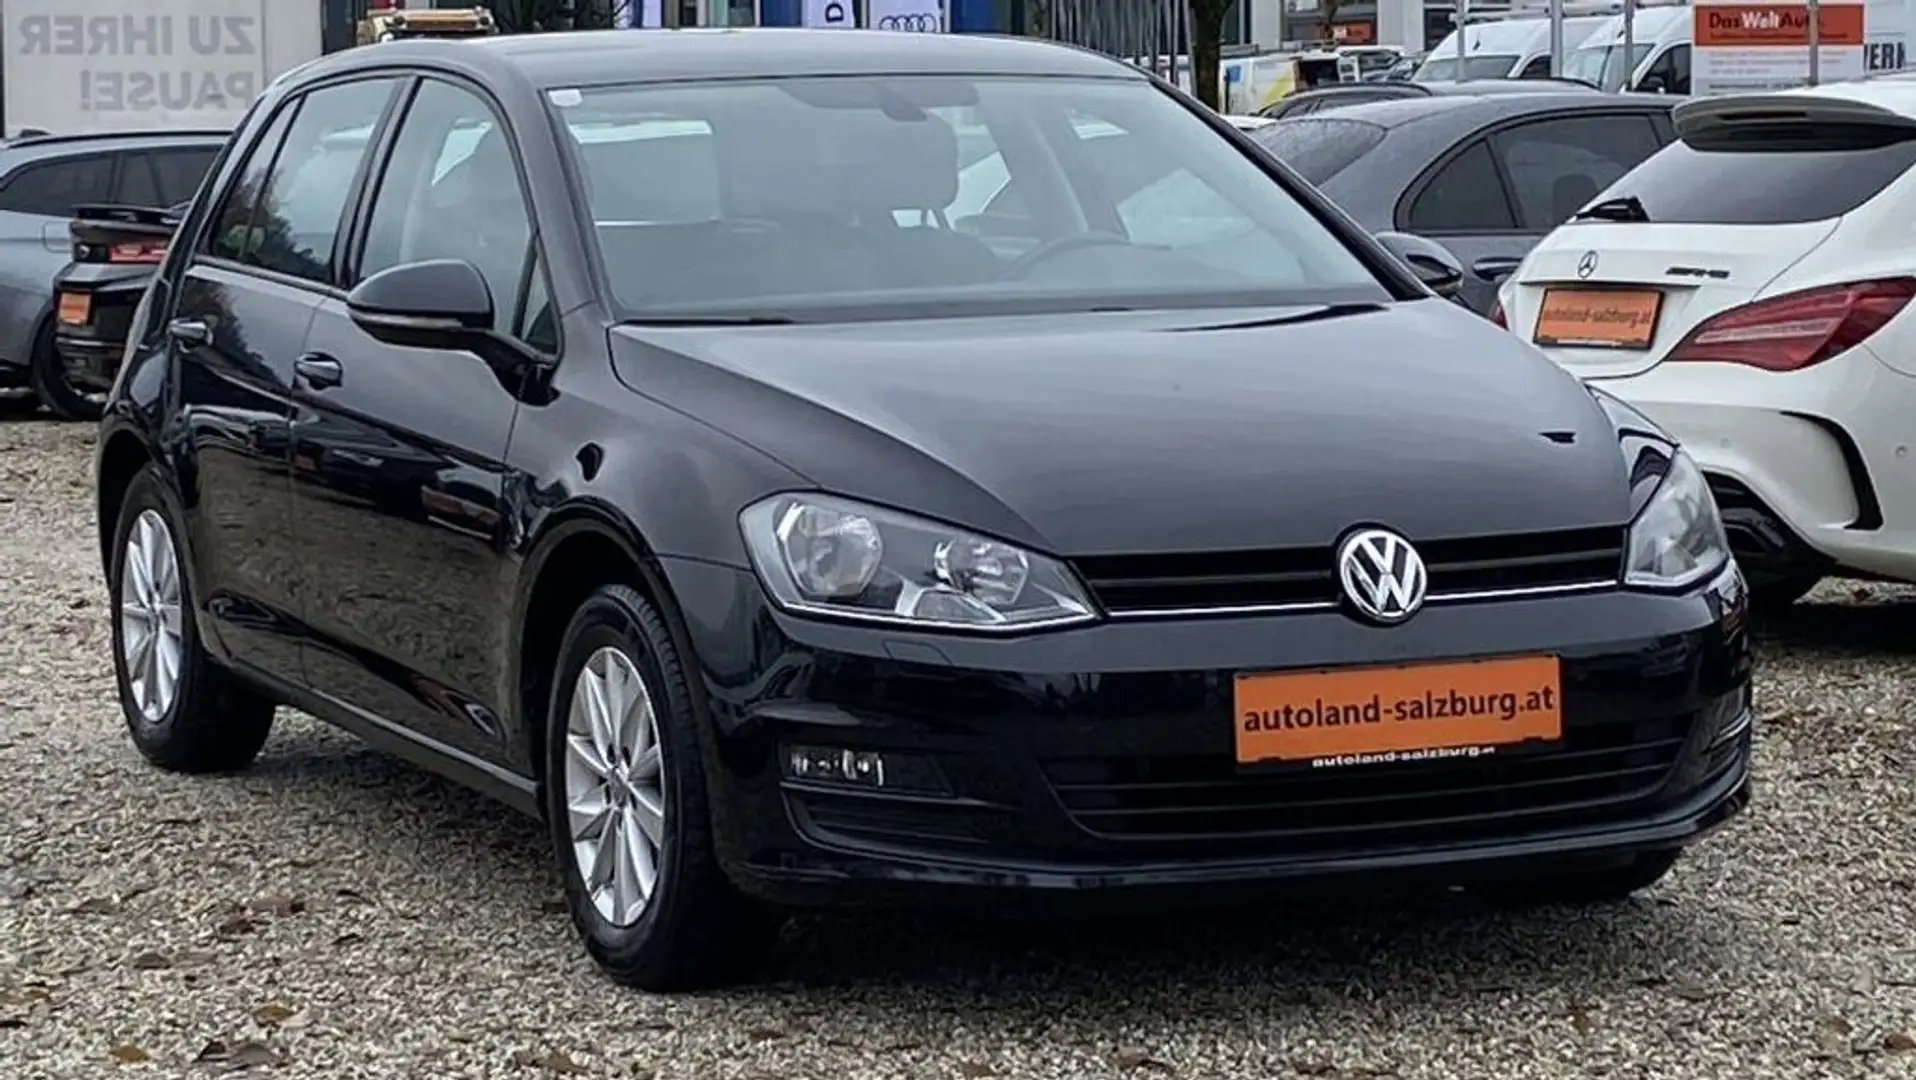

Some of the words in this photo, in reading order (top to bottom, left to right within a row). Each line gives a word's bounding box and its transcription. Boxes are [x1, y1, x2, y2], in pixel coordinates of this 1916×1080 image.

[1708, 11, 1824, 29] DasWeltAut.
[1244, 685, 1555, 732] autoland-salzburg.at
[1312, 745, 1495, 768] autoland-salzburg.at
